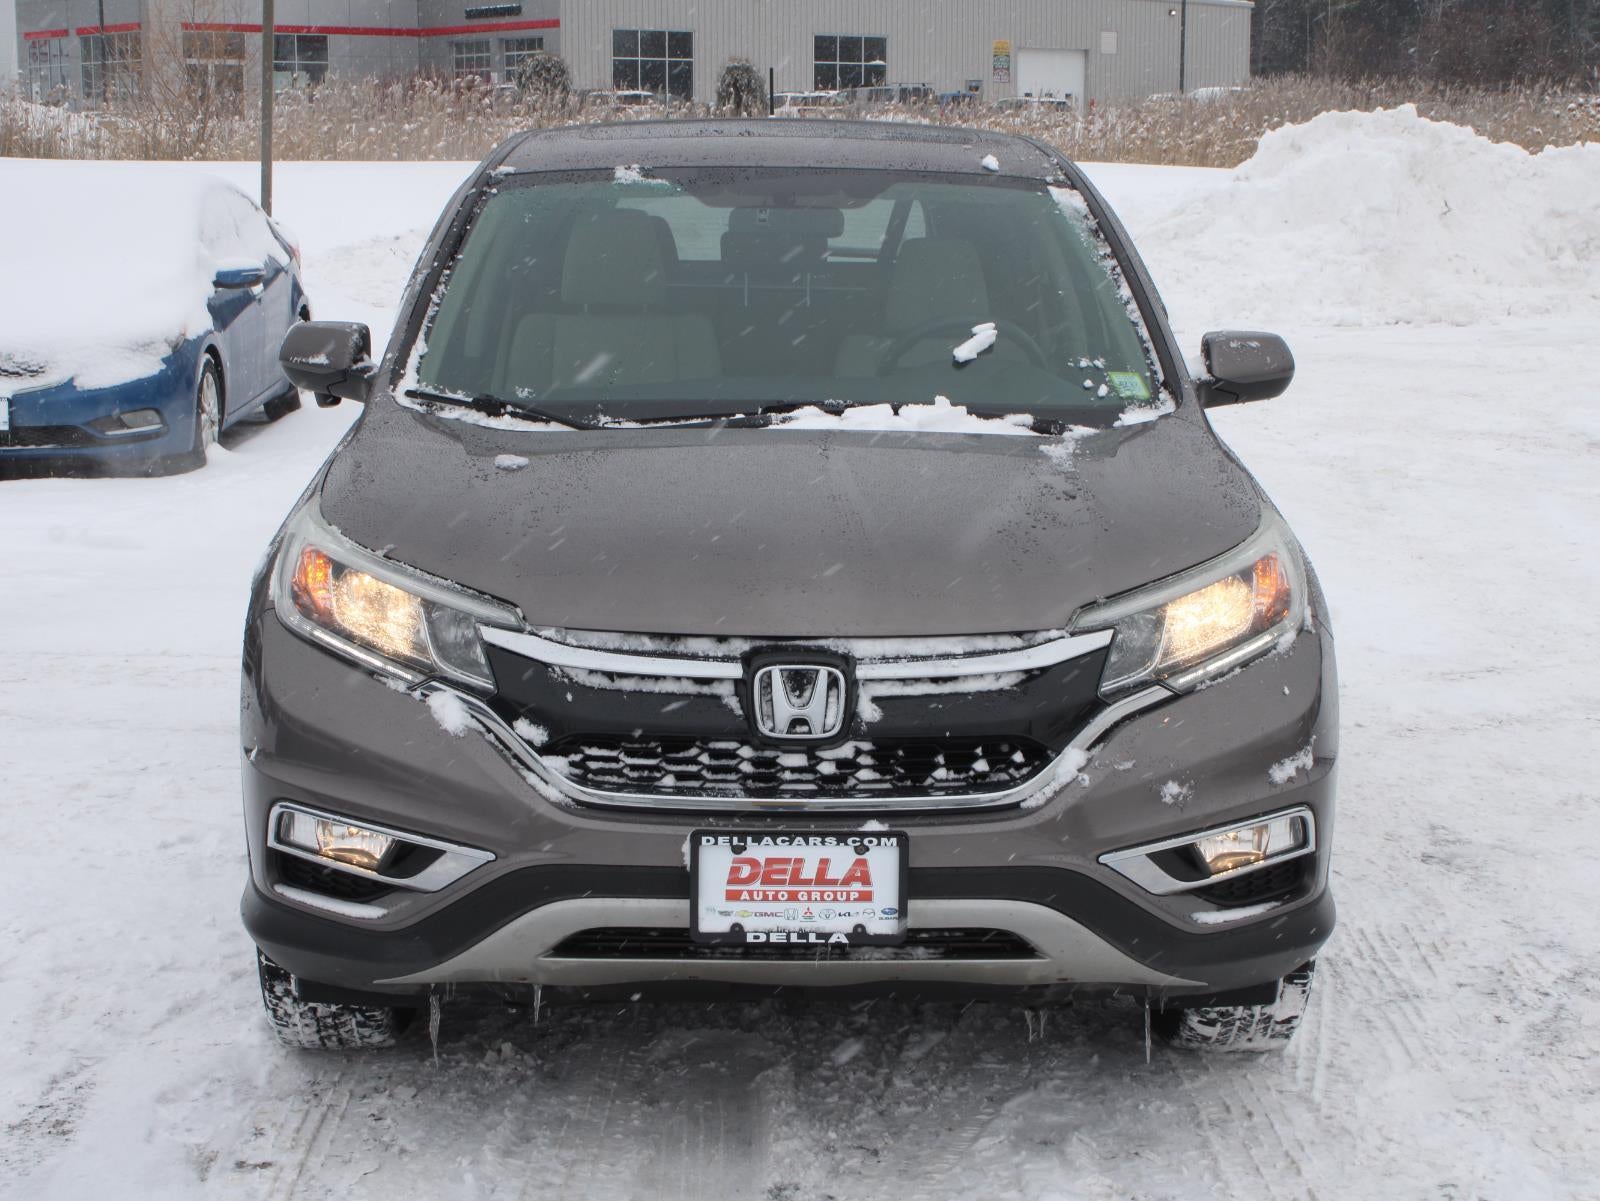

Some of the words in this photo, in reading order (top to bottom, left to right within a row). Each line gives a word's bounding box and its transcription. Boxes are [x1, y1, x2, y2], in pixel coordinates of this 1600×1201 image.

[701, 836, 898, 847] DELLACARS.COM
[727, 857, 873, 887] DELLA
[740, 890, 788, 901] AUTO
[797, 891, 860, 901] GROUP
[746, 933, 850, 944] DELLA
